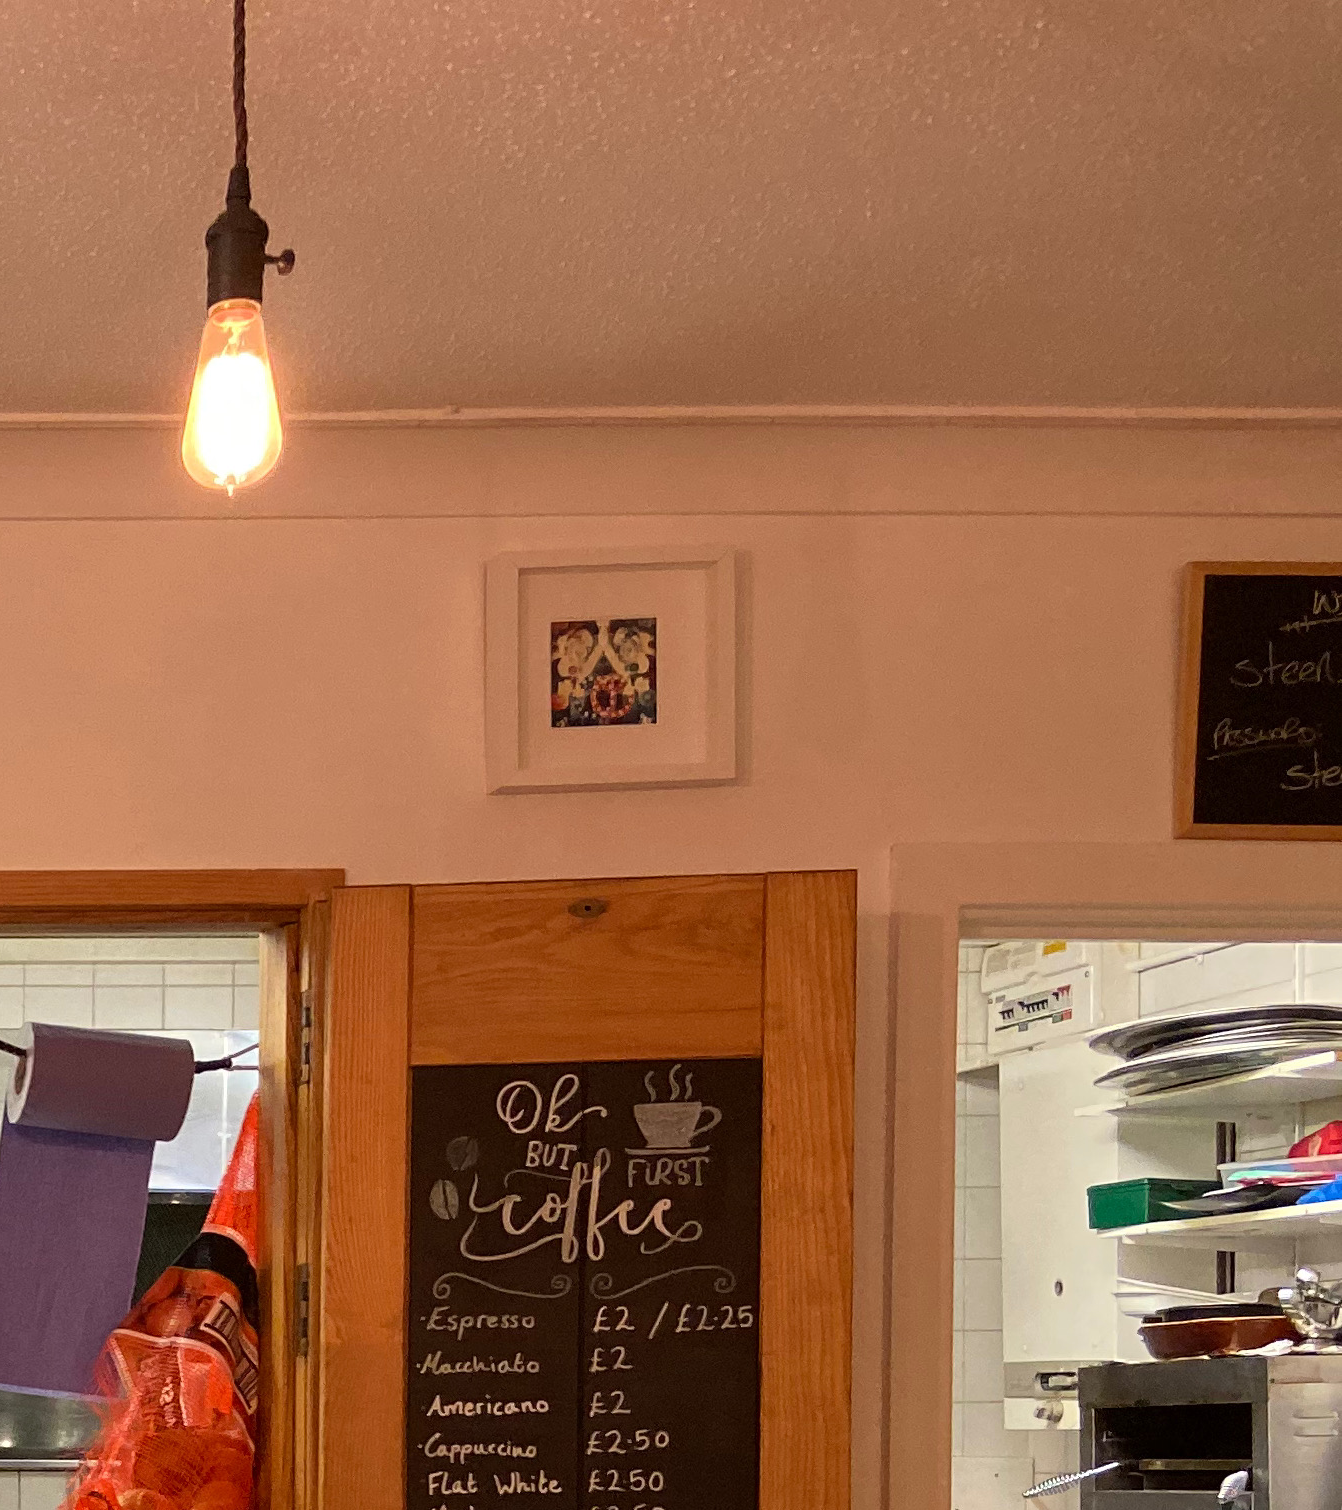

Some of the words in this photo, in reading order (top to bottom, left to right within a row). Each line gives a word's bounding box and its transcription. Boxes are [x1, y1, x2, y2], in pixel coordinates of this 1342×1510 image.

[496, 1074, 608, 1134] Ok
[525, 1141, 578, 1171] BUT
[627, 1156, 710, 1188] FIRST
[469, 1148, 702, 1263] coffee
[426, 1306, 536, 1340] Espresso
[593, 1305, 636, 1333] £2
[420, 1350, 540, 1377] Macchiato
[589, 1344, 633, 1372] £2
[426, 1394, 550, 1418] Americano
[589, 1390, 632, 1417] £2
[424, 1432, 538, 1468] Cappuccino
[493, 1469, 563, 1495] White
